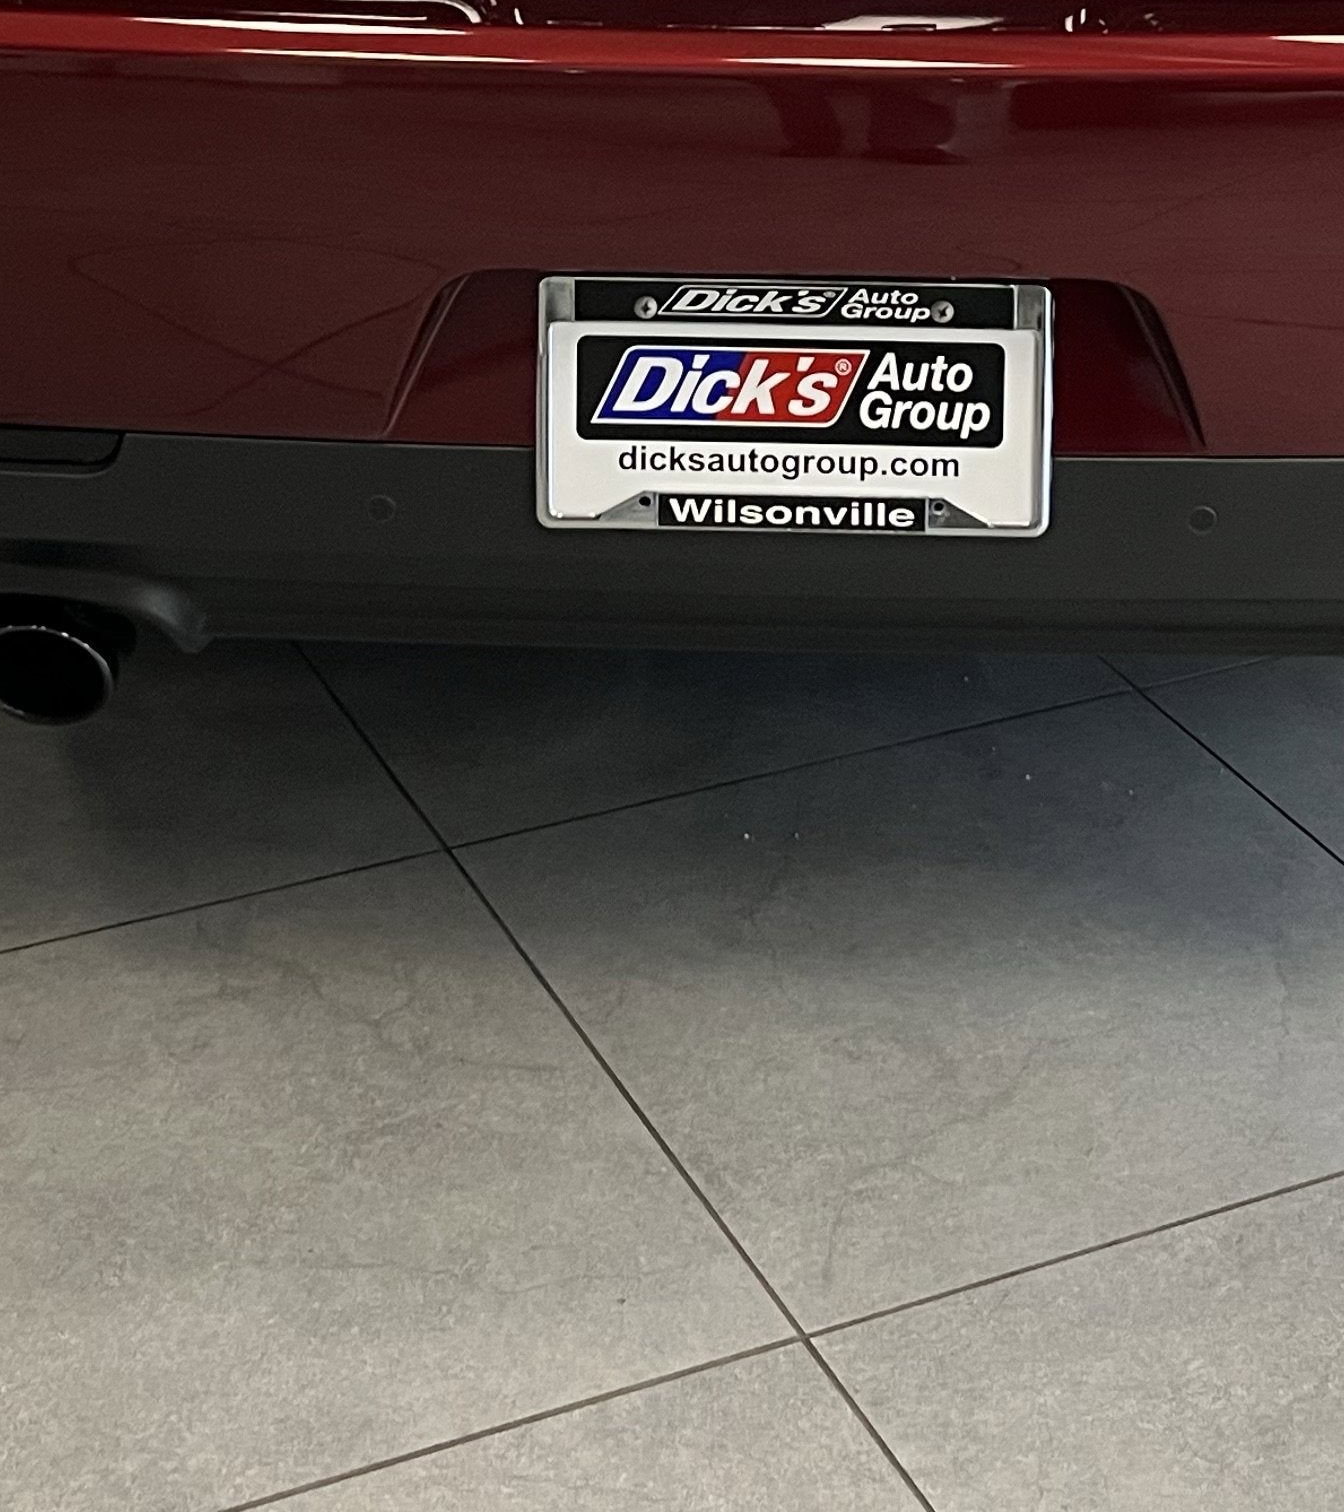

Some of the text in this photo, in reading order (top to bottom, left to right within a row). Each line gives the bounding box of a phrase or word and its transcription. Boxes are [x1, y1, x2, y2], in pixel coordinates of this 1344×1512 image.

[840, 302, 931, 323] Group
[848, 288, 918, 305] Auto
[867, 352, 973, 392] Auto
[859, 390, 991, 439] Group
[618, 446, 960, 481] dicksautogroup.com
[668, 497, 915, 528] Wilsonville
